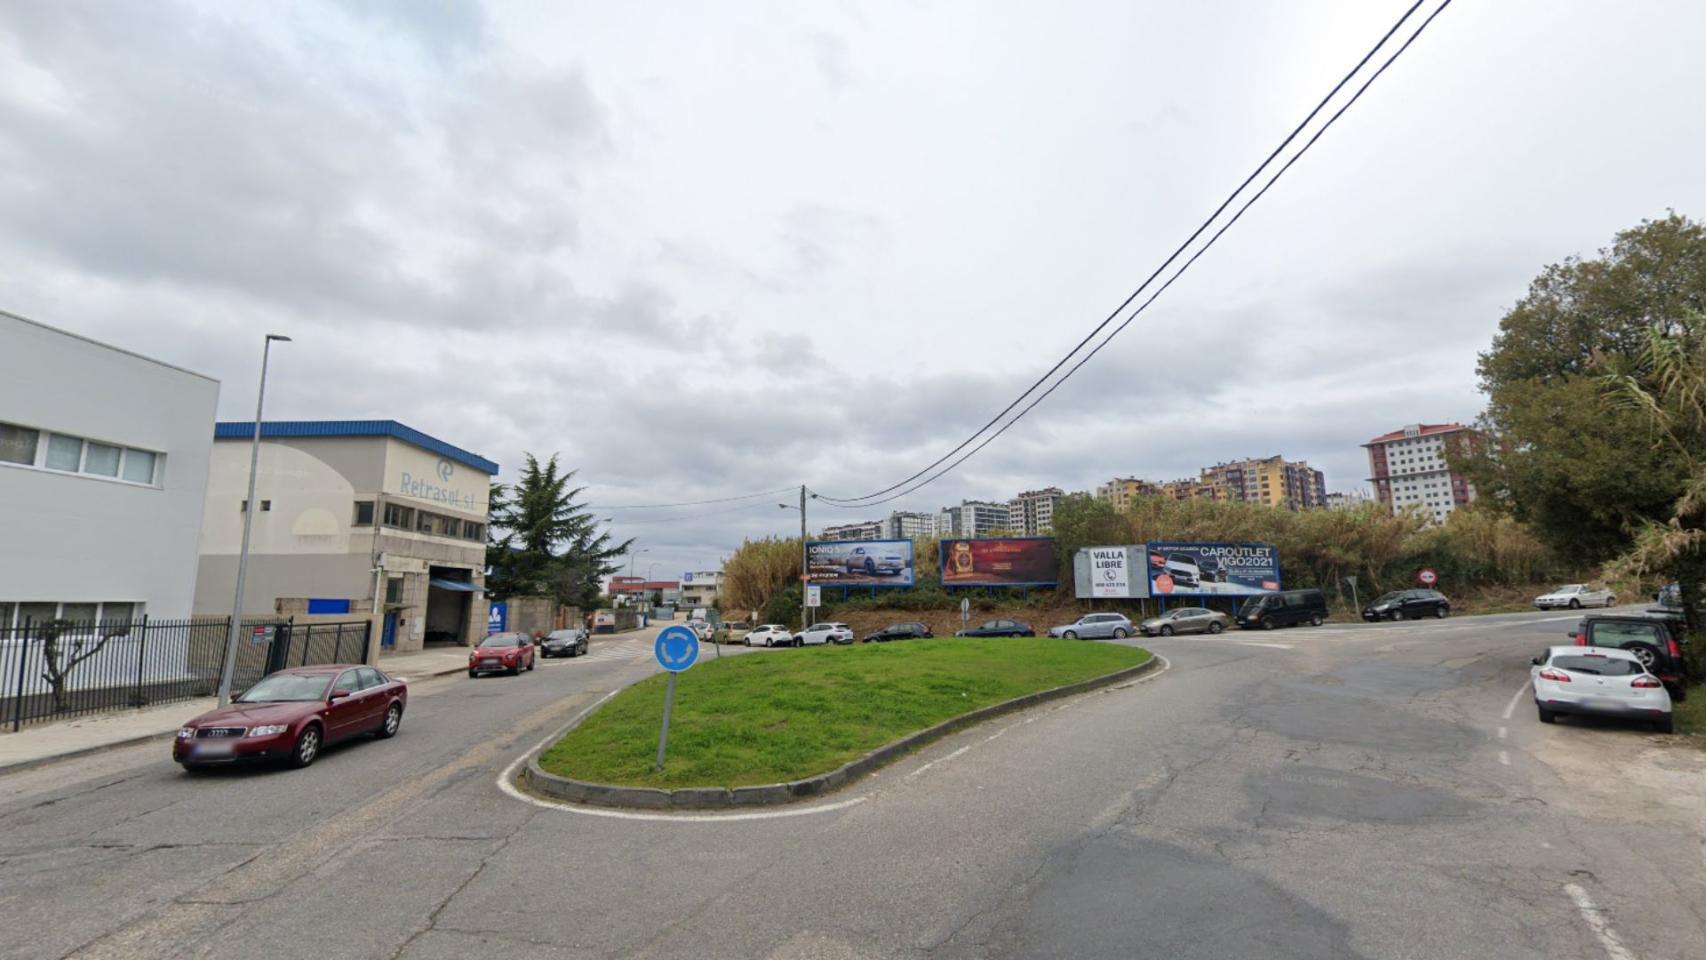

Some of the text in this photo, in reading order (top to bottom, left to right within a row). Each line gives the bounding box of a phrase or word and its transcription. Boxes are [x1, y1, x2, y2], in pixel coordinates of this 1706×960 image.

[809, 546, 834, 554] IONIQ
[1200, 547, 1271, 557] CAROUTLET
[1093, 551, 1124, 560] VALLA
[1096, 560, 1122, 569] LIBRE
[1216, 557, 1273, 567] VIGO2021
